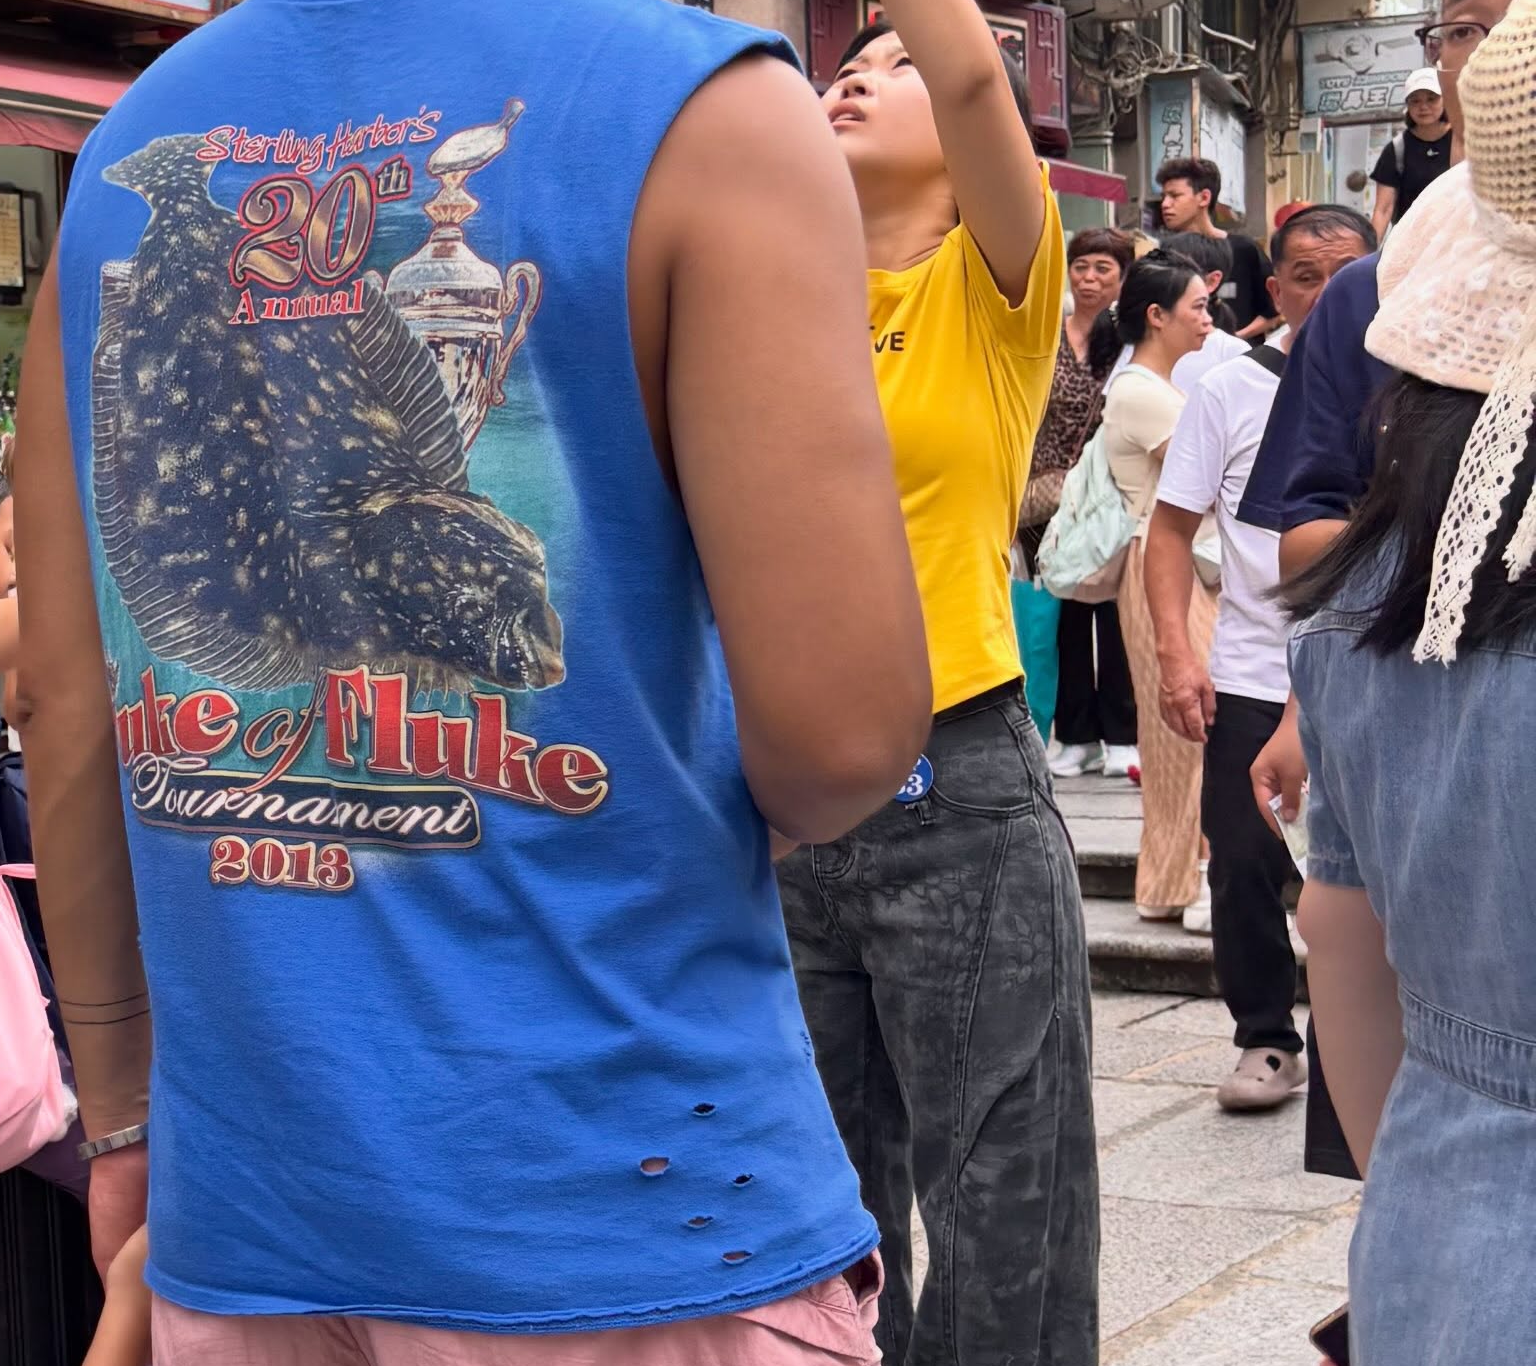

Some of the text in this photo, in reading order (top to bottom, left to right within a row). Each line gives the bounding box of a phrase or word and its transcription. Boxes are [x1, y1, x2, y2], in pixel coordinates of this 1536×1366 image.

[195, 104, 442, 175] Sterling Harbor's
[228, 280, 365, 325] Annual
[115, 663, 609, 815] uke of Fluke
[131, 751, 473, 835] Tournament
[209, 835, 355, 892] 2013
